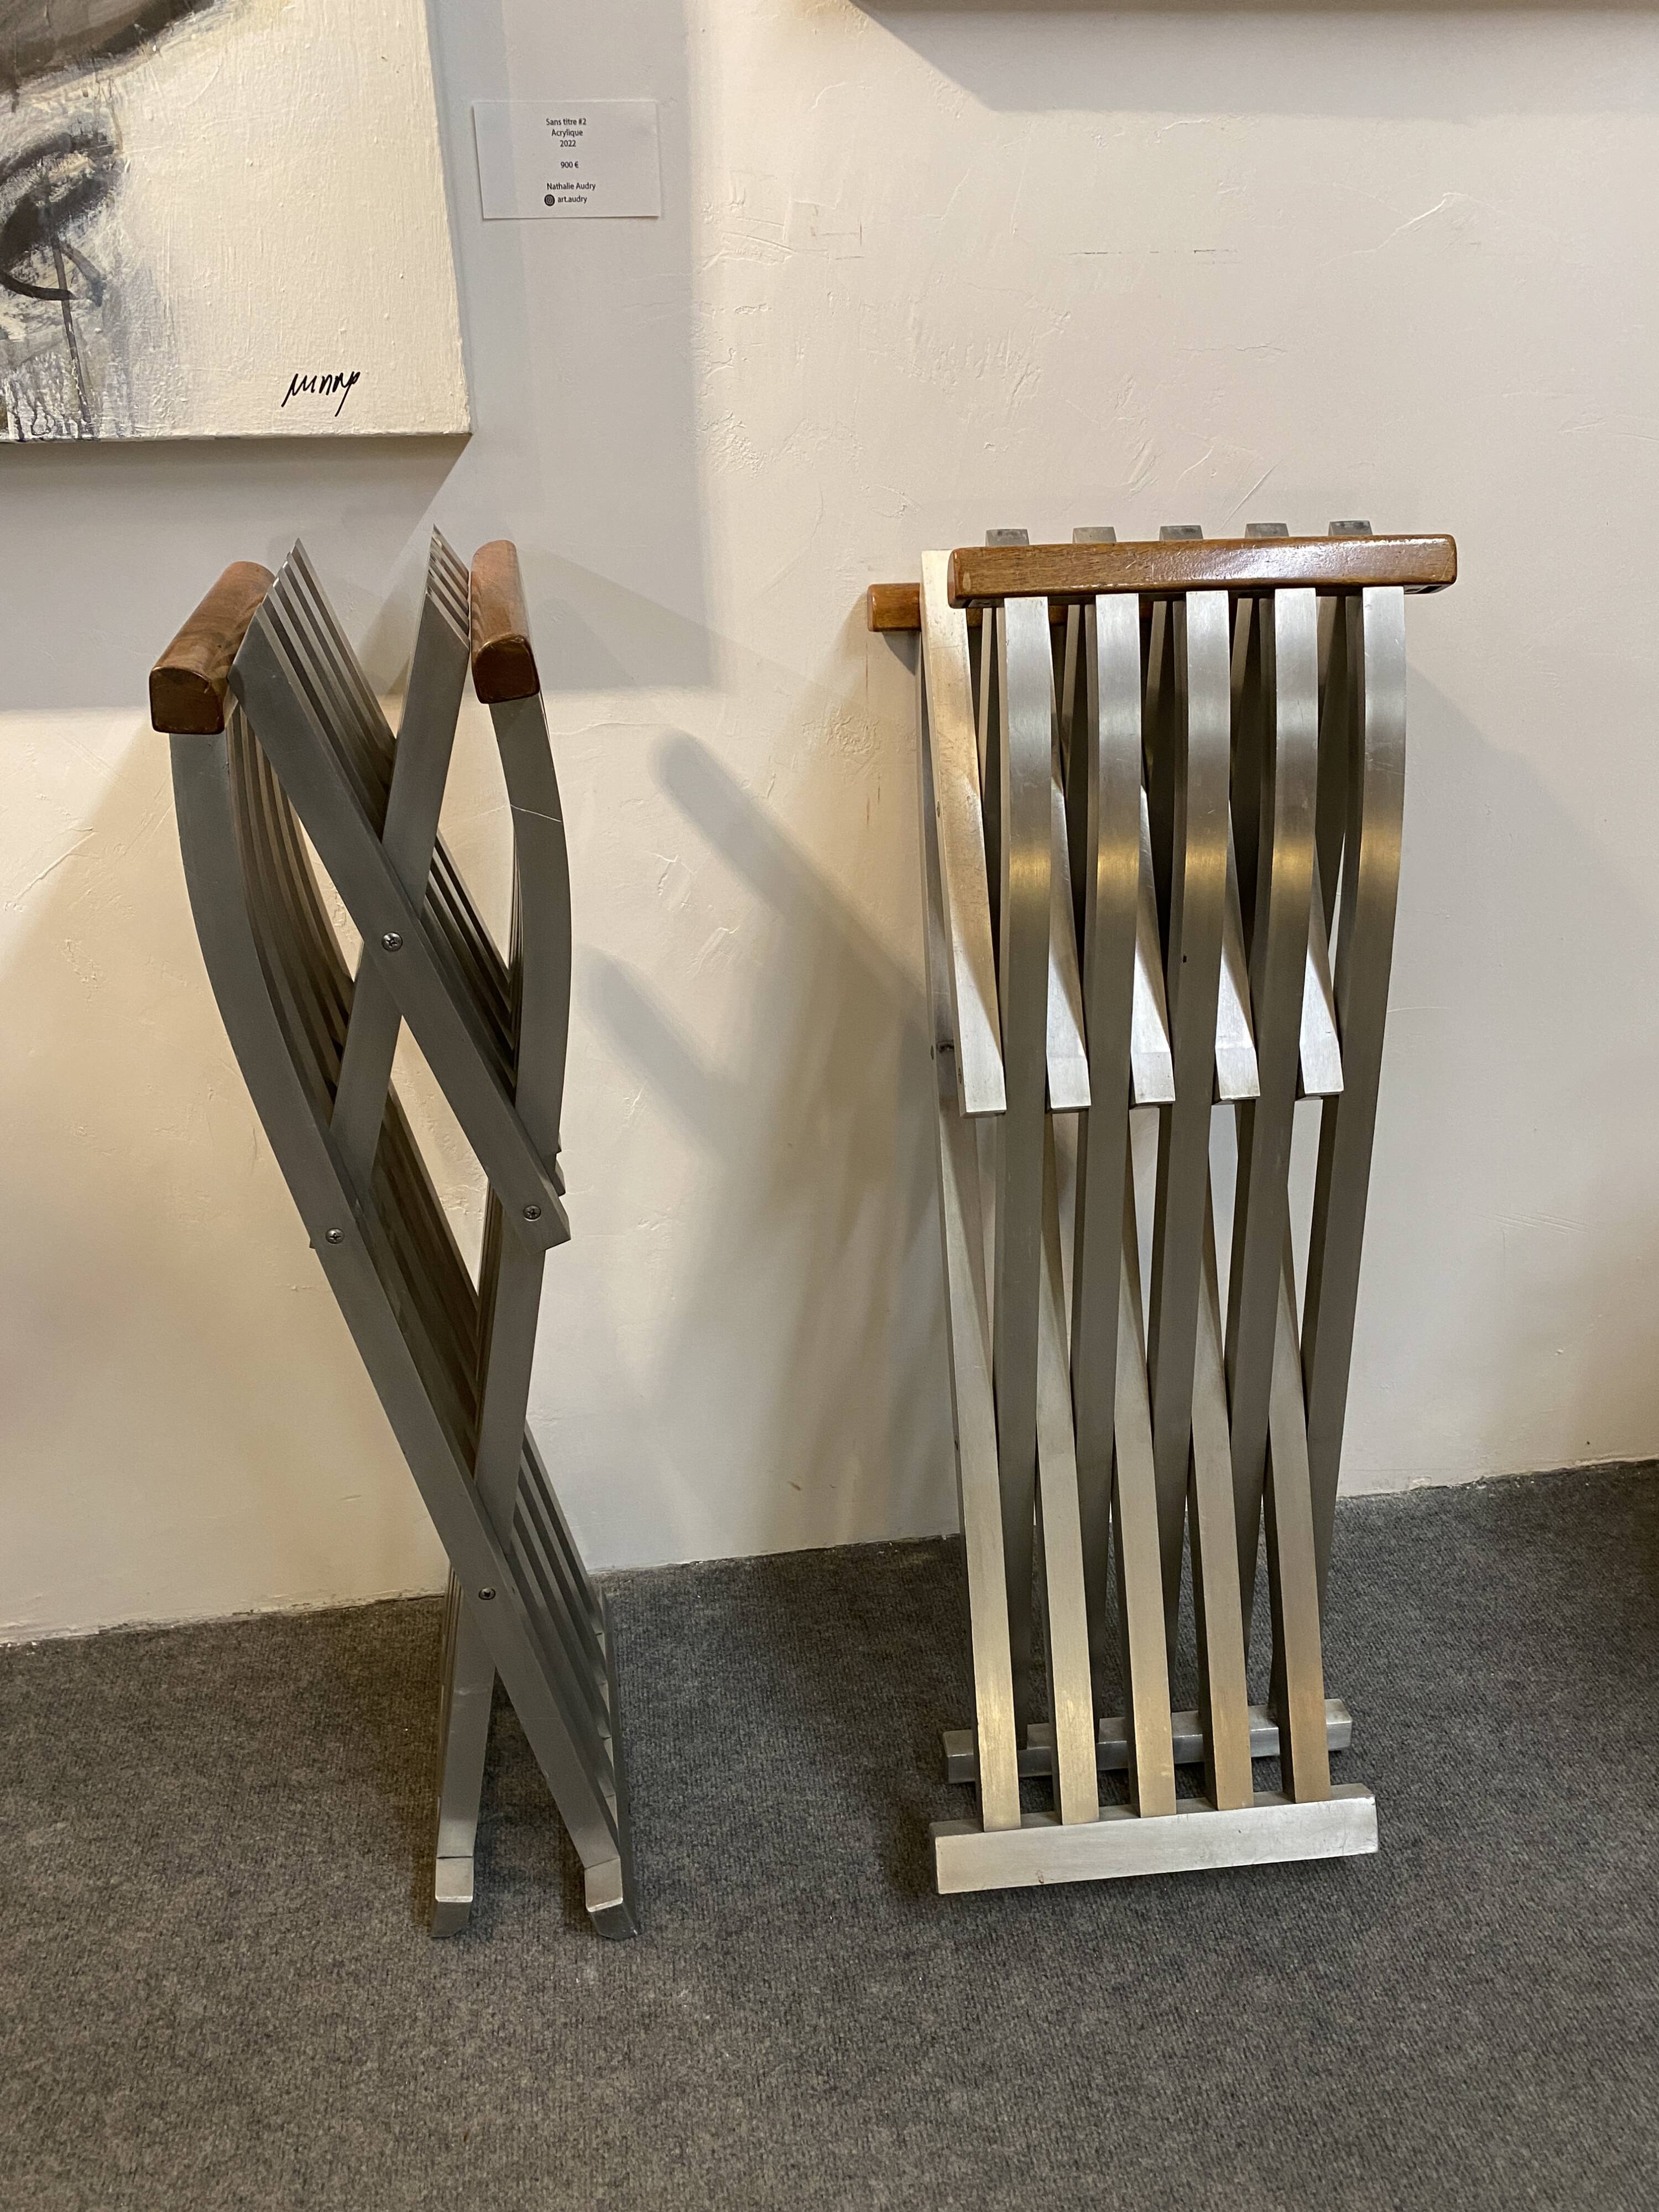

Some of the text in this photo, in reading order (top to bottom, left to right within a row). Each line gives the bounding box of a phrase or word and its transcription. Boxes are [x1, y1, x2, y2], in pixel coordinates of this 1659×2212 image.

[551, 128, 583, 138] Acrylique
[576, 182, 596, 191] Audry
[557, 195, 587, 204] art.audry
